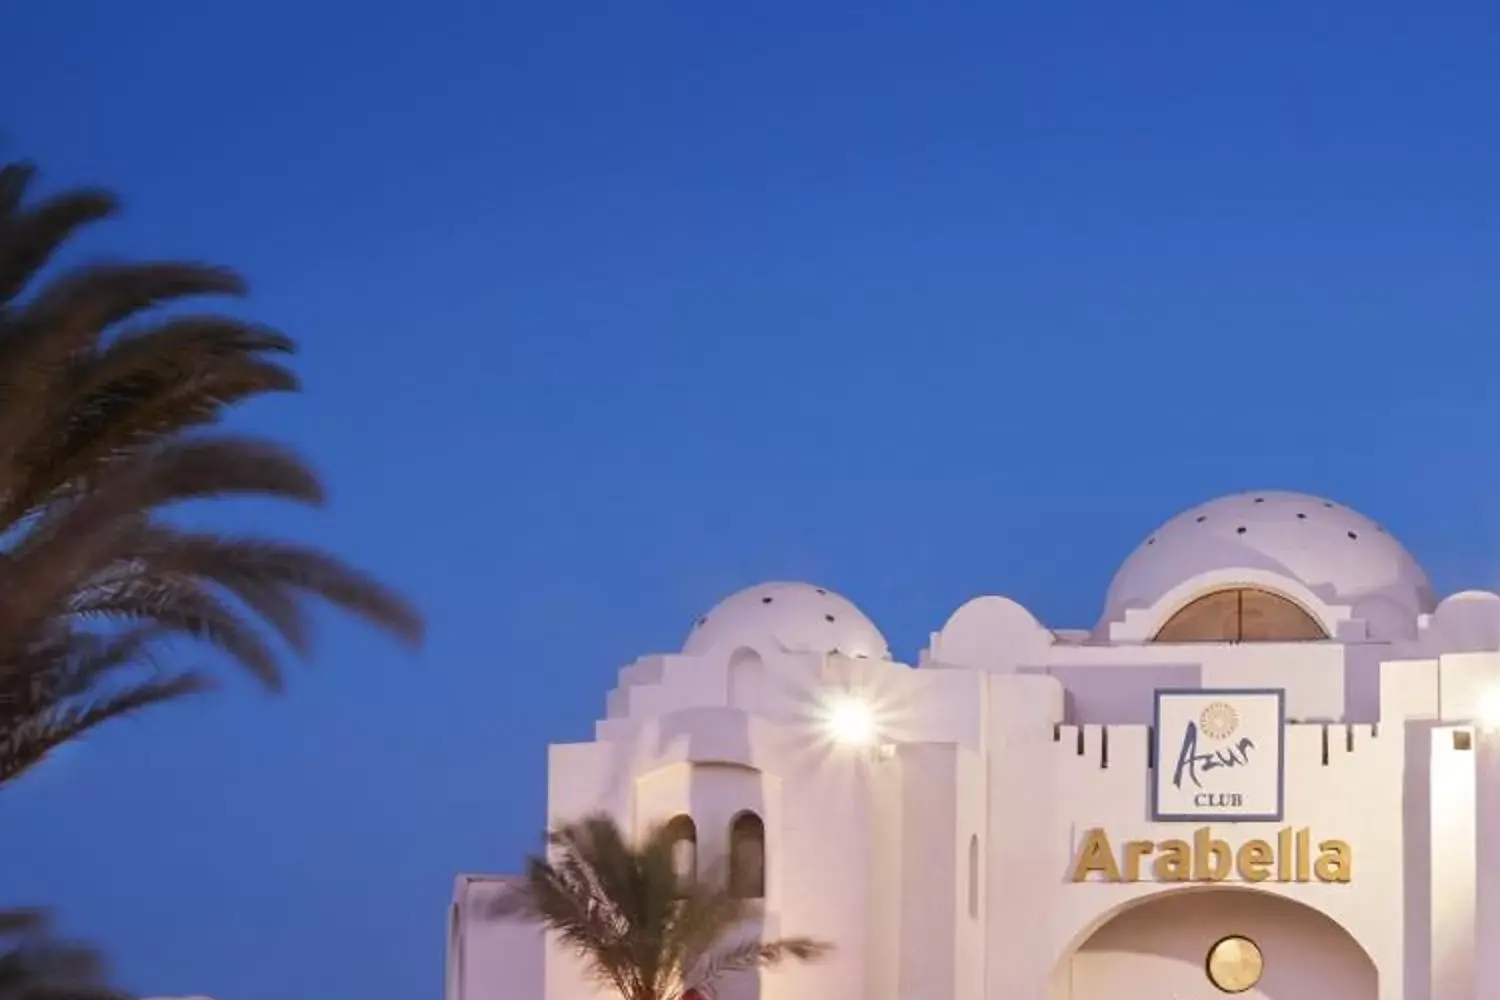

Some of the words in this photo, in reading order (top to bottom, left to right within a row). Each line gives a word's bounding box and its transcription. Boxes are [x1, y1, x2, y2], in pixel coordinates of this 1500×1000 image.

[1172, 720, 1256, 789] Azur
[1194, 793, 1243, 808] CLUB
[1069, 826, 1352, 883] Arabella
